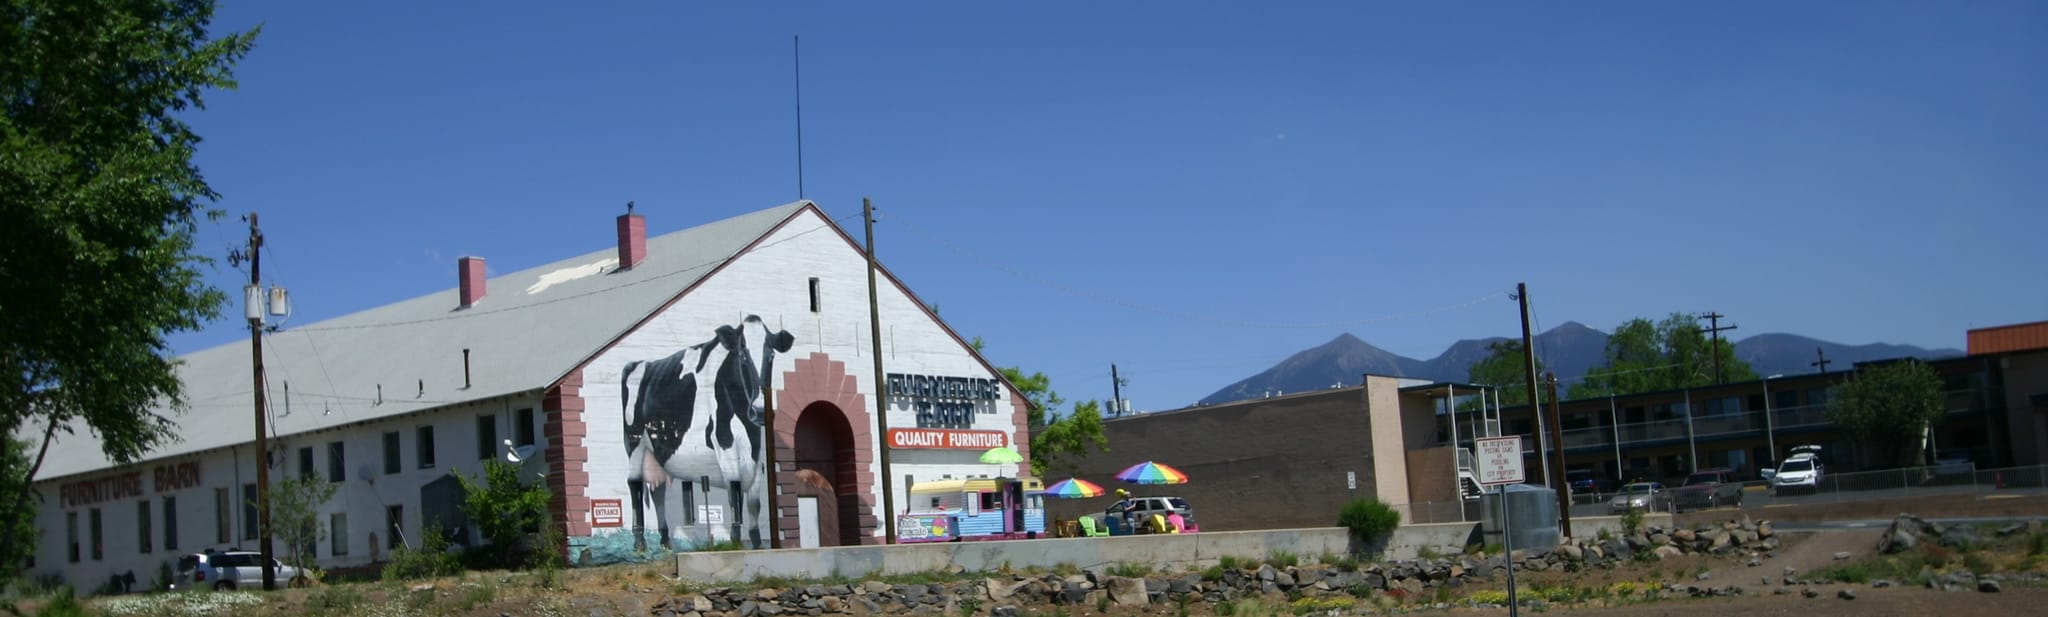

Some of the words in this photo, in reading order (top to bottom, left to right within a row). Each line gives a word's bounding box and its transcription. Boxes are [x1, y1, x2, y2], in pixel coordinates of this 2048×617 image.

[886, 373, 1000, 400] FURNITURE
[917, 401, 975, 424] BARN
[895, 431, 944, 446] QUALITY
[949, 433, 1003, 447] FURNITURE
[60, 471, 143, 508] FURNITURE
[154, 461, 200, 492] BARN
[595, 508, 619, 516] ENTRANCE
